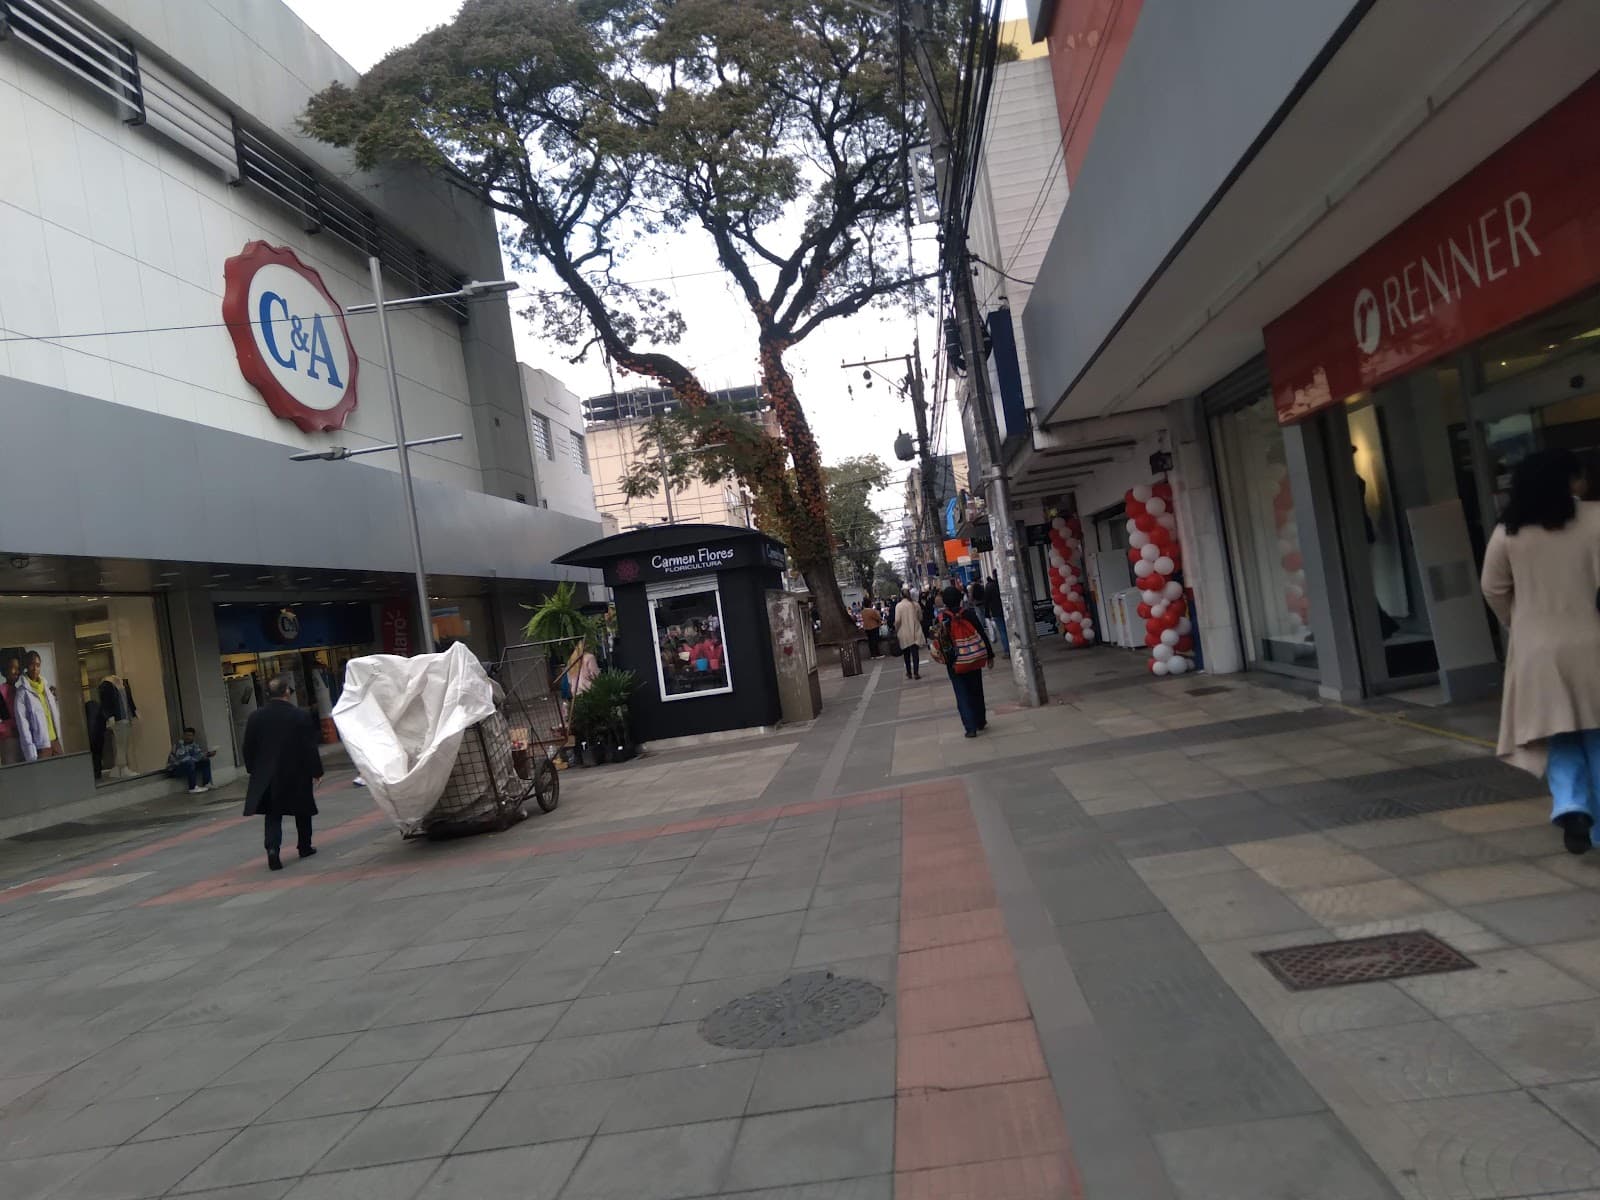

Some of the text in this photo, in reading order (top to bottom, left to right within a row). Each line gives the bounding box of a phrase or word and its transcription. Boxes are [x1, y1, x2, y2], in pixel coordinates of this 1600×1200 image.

[1383, 191, 1542, 336] RENNER
[258, 290, 344, 389] C&A
[651, 547, 734, 569] Carmen Flores
[664, 560, 723, 573] FLORICULTURA
